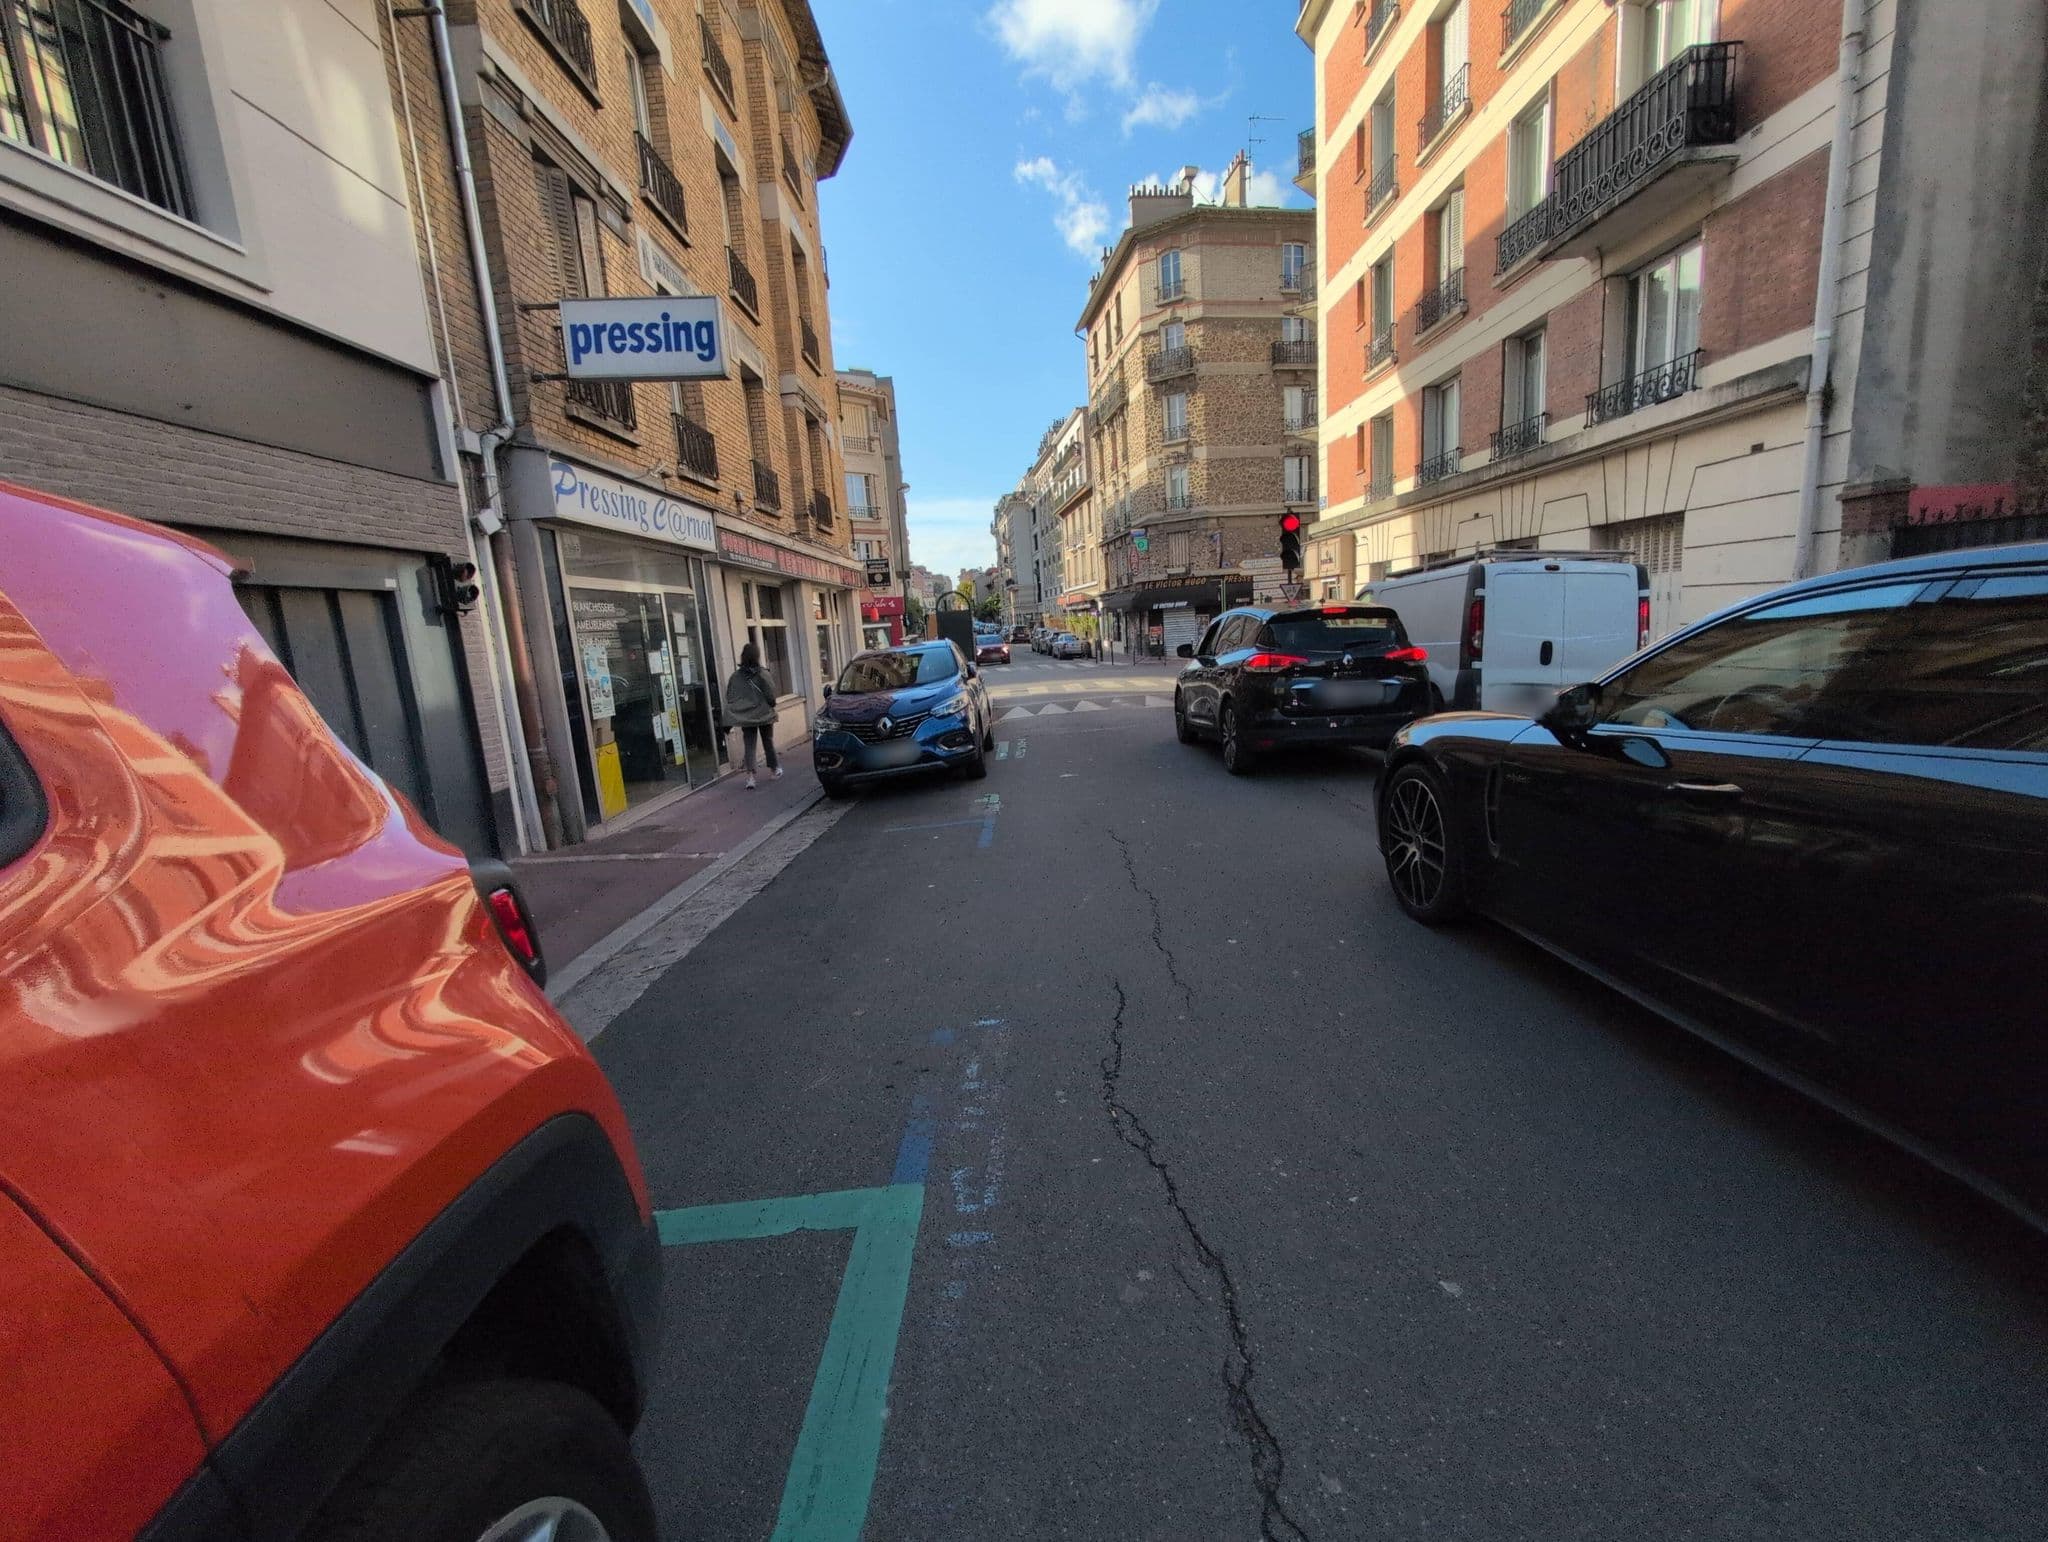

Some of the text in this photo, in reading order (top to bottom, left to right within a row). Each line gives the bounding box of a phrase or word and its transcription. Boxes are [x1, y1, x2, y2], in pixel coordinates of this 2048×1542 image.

[569, 312, 715, 365] pressing
[551, 463, 713, 541] Pressing C@rnot
[1155, 579, 1182, 589] VICTOR
[1184, 577, 1207, 586] HUGO
[1224, 575, 1251, 583] PRESSE
